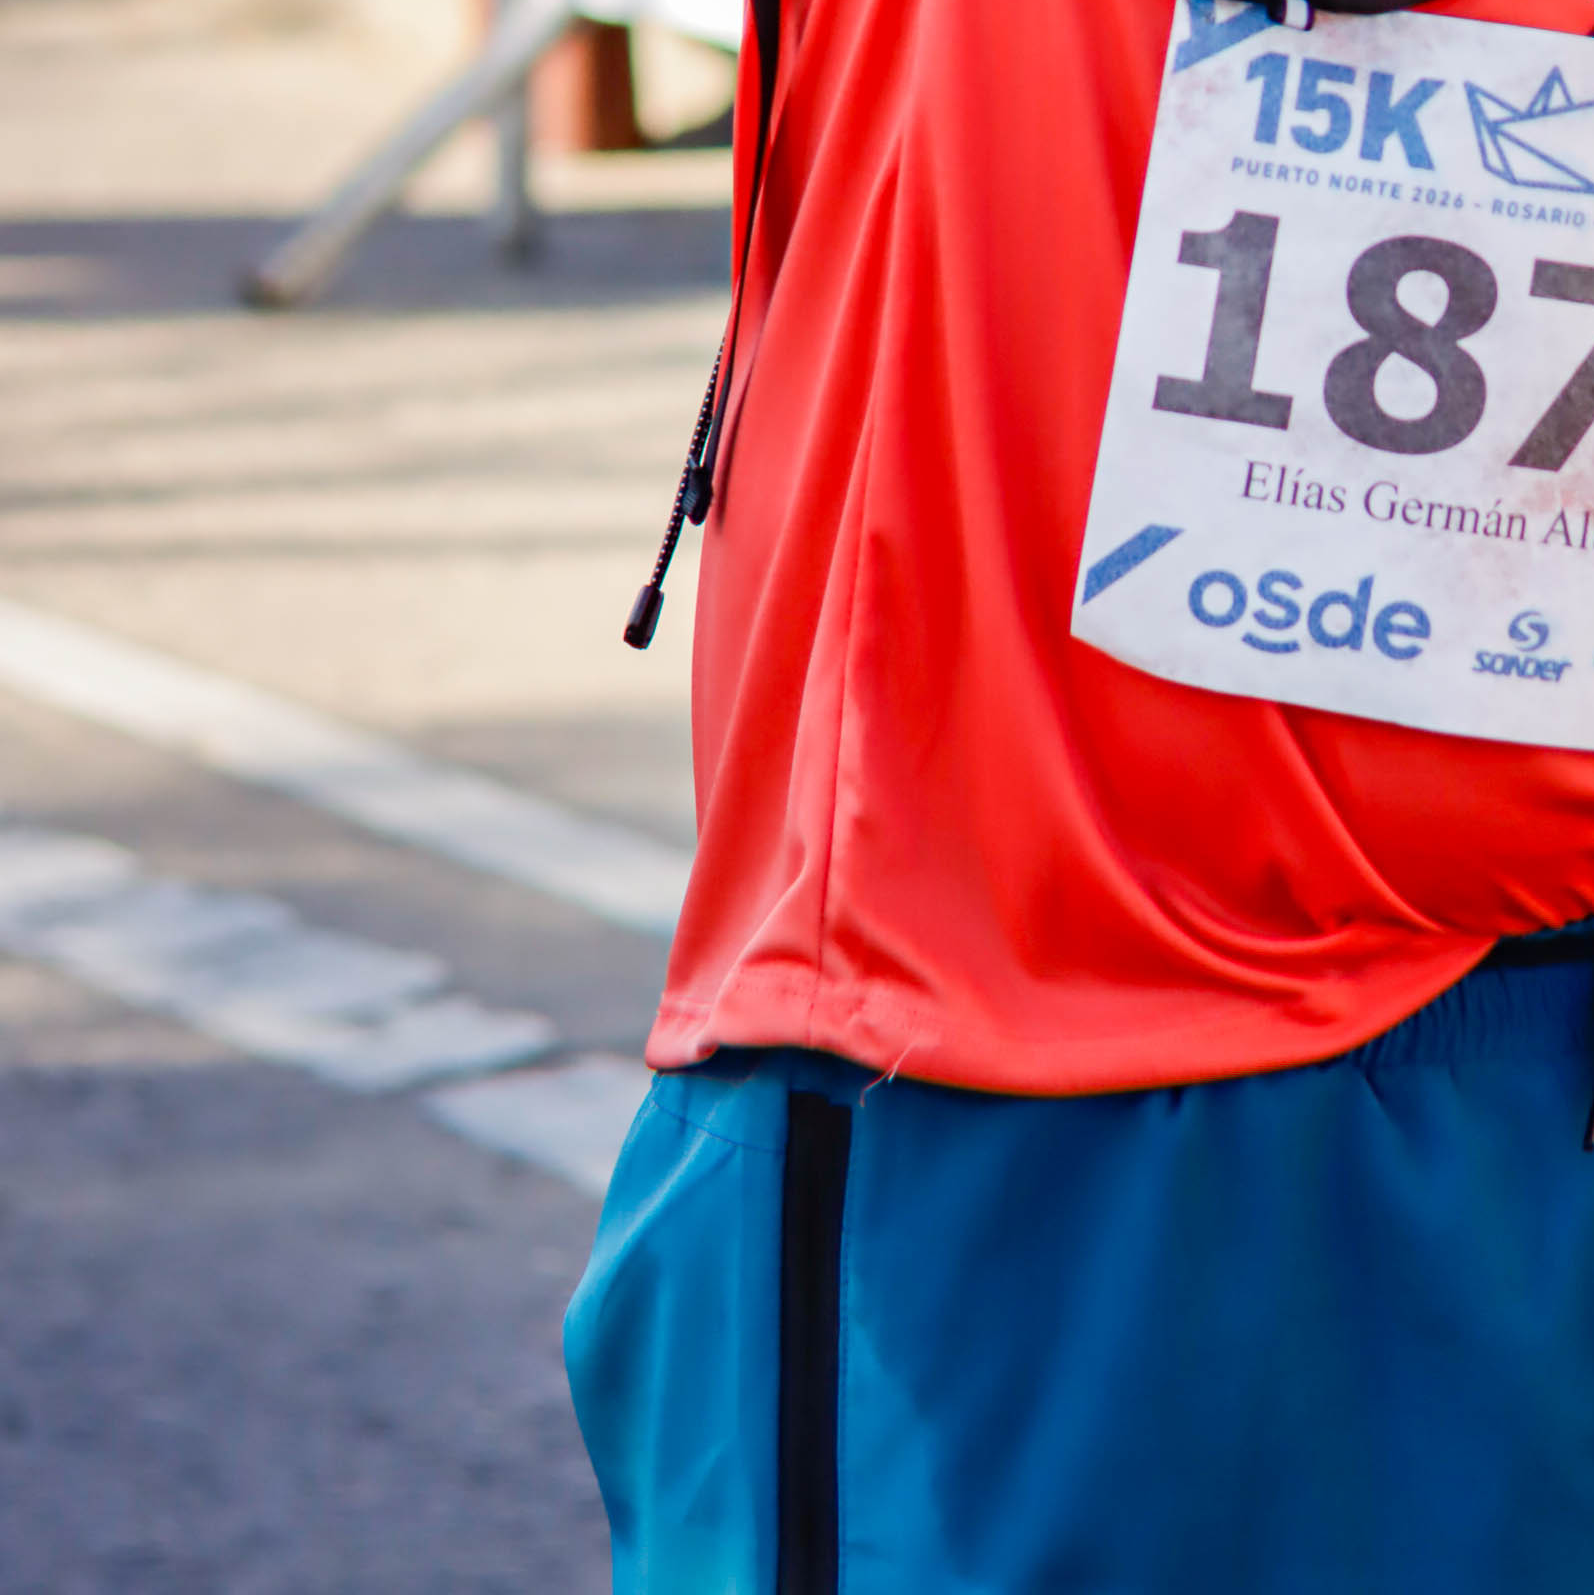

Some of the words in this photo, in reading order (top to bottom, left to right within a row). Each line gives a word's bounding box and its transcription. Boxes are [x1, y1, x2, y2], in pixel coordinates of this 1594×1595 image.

[1246, 51, 1445, 171] 15K
[1231, 156, 1319, 186] PUERTO
[1328, 173, 1402, 200] NORTE
[1411, 186, 1465, 210] 2026
[1491, 197, 1586, 228] ROSARIO
[1240, 459, 1347, 514] Elías
[1363, 480, 1528, 542] Germán
[1188, 568, 1432, 661] osde
